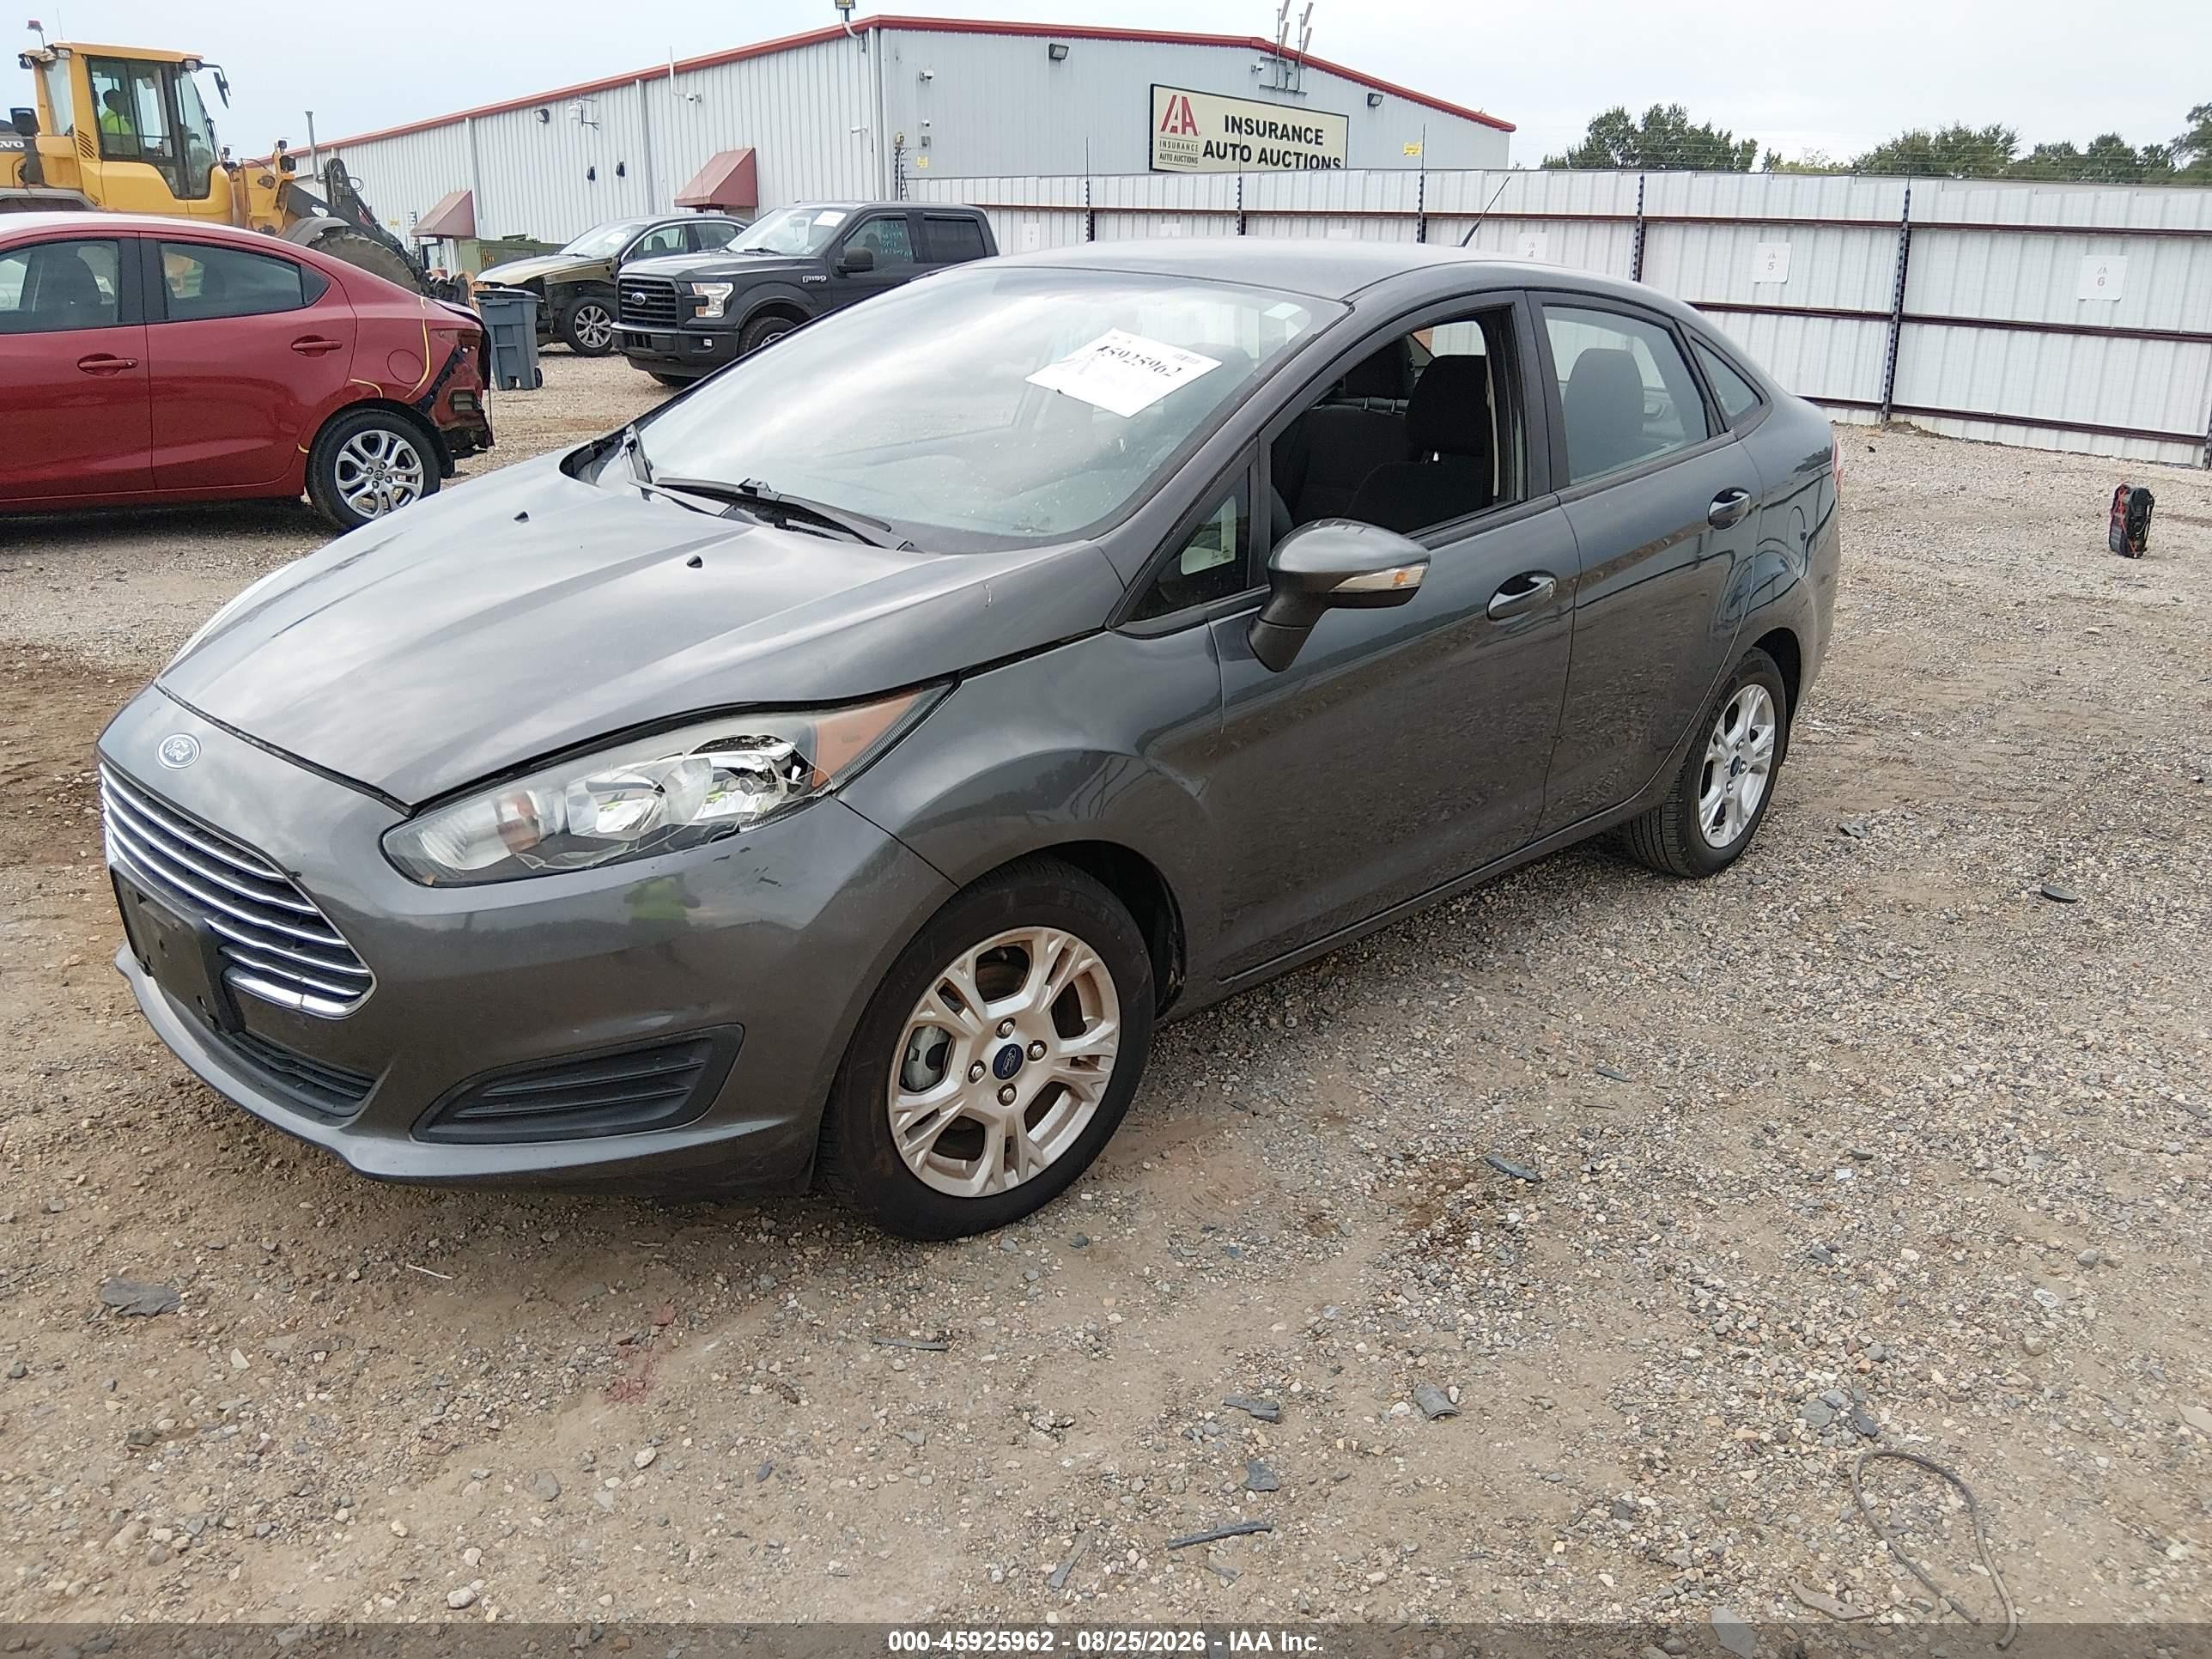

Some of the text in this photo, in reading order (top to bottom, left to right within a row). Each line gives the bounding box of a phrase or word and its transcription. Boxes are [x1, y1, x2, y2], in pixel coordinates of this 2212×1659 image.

[1224, 115, 1324, 146] INSURANCE
[1159, 140, 1199, 152] INSURANCE
[1159, 153, 1199, 164] AUTO AUCTIONS
[1202, 140, 1341, 169] AUTO AUCTIONS
[1767, 261, 1775, 270] 5
[2097, 276, 2106, 287] 6
[164, 739, 190, 762] Ford
